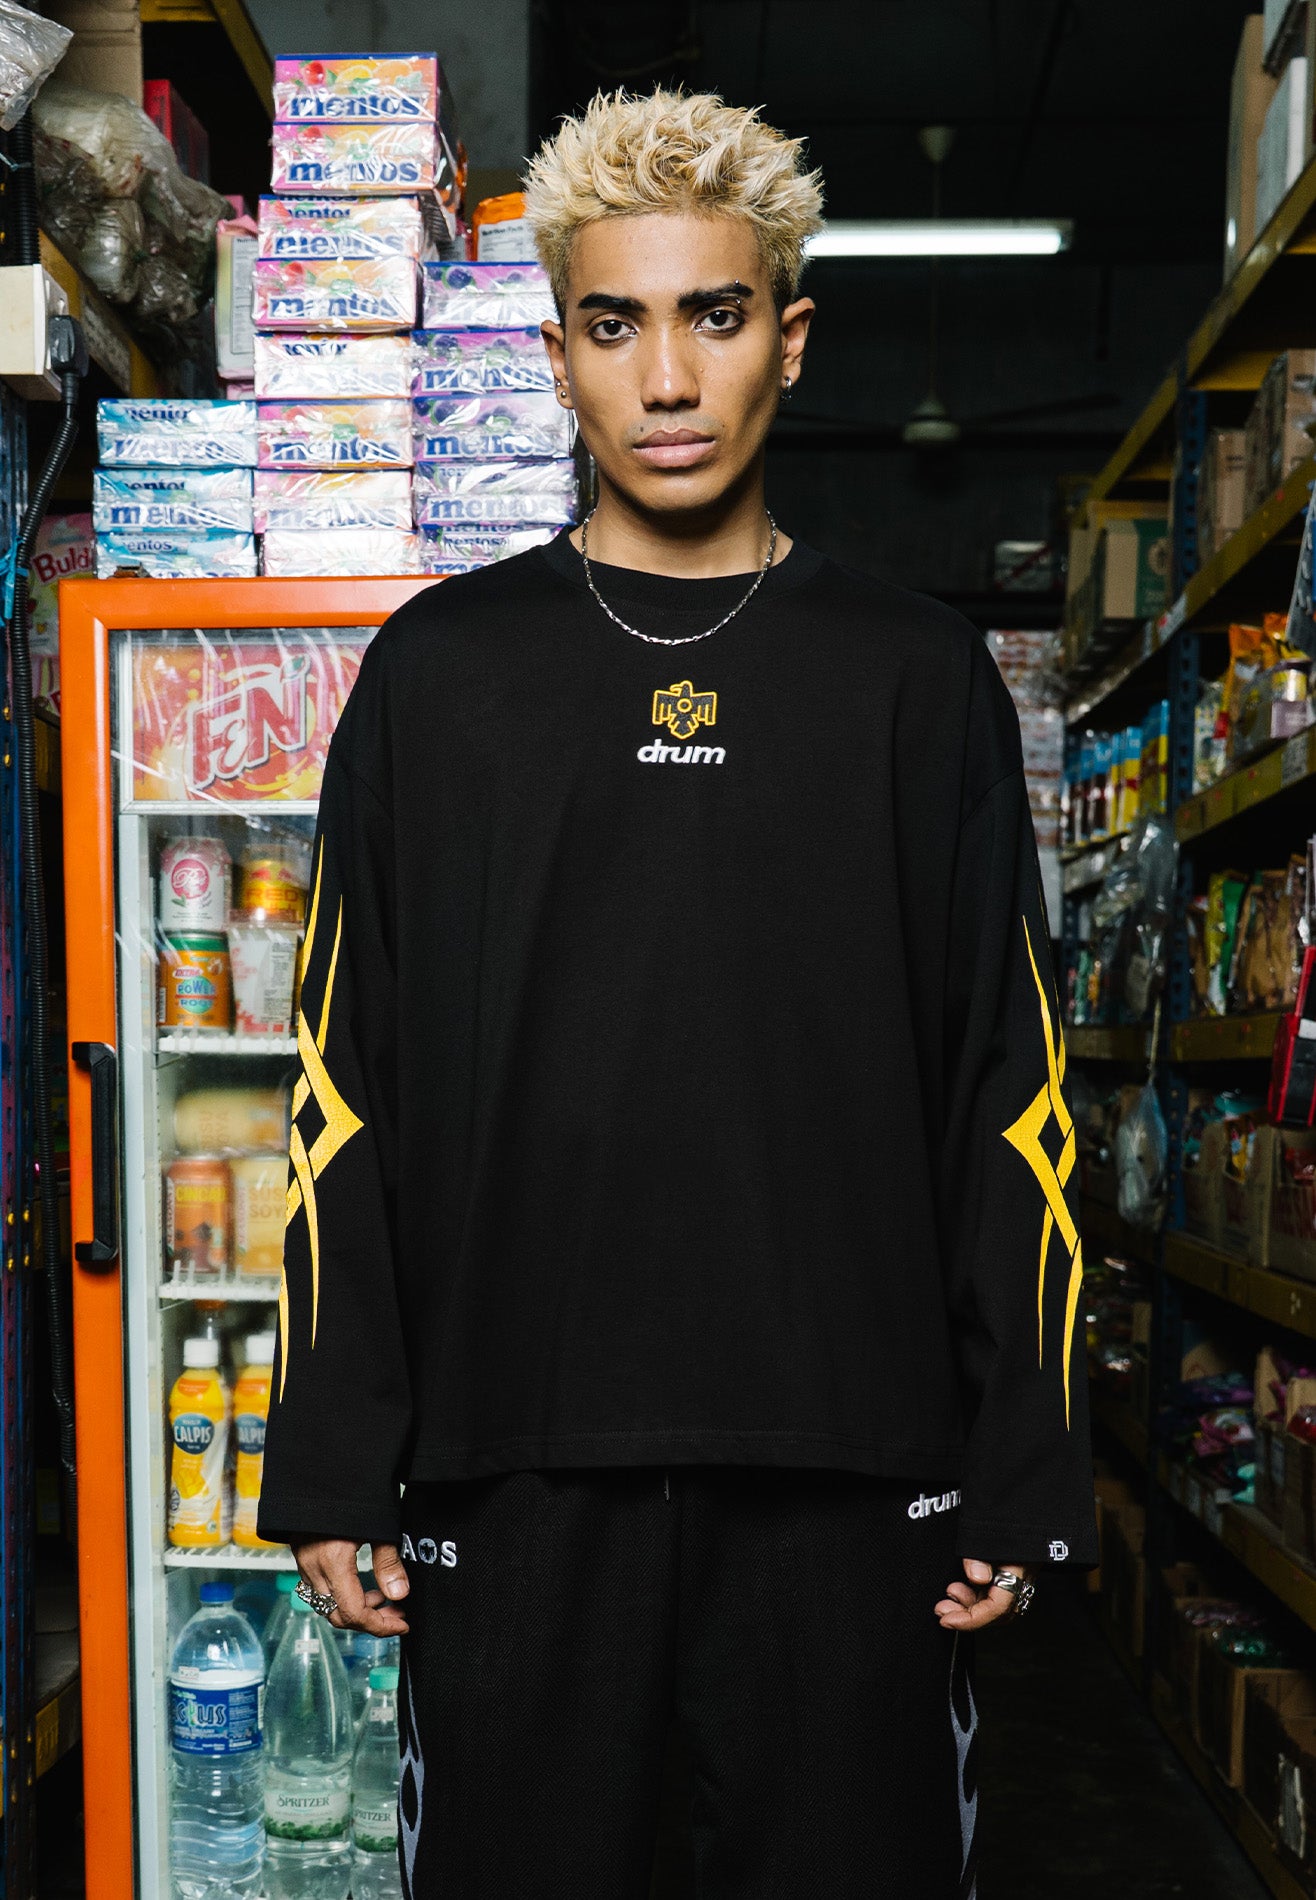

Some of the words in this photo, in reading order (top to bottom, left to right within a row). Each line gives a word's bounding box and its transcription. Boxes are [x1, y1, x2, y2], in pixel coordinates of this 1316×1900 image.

[290, 94, 419, 116] mentos
[122, 540, 172, 551] entos
[637, 739, 726, 764] drum
[173, 1425, 212, 1444] CALPIS
[278, 1795, 330, 1808] SPRITZER
